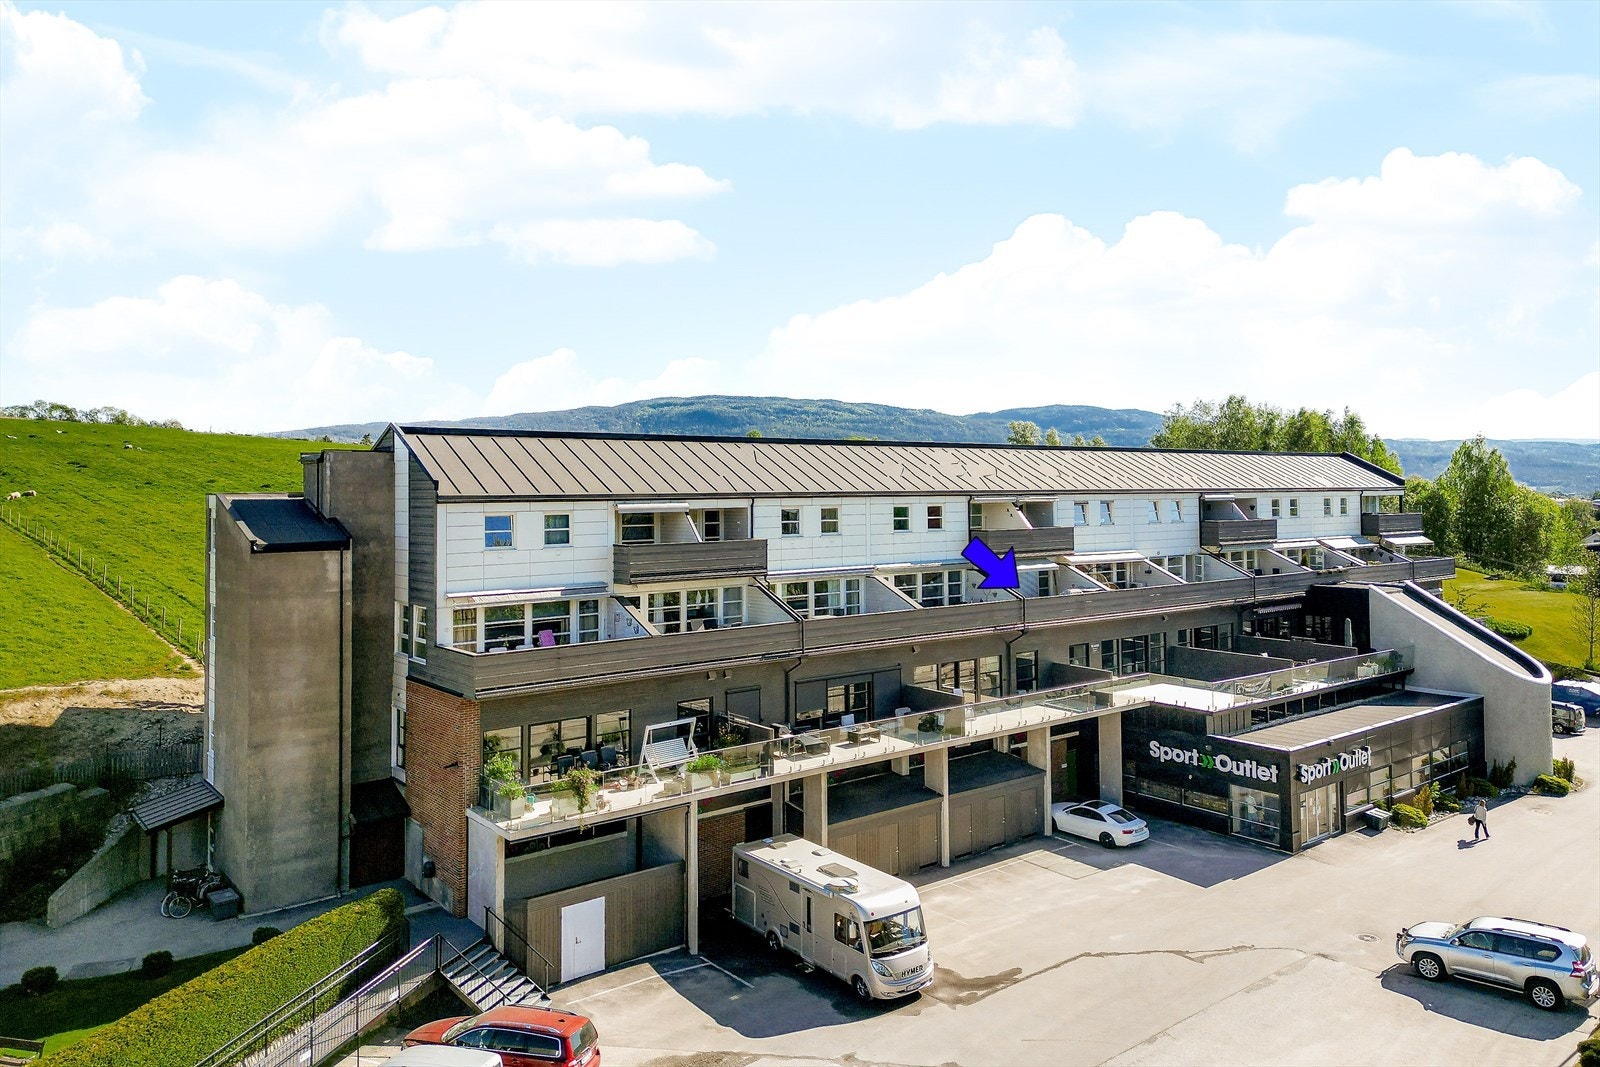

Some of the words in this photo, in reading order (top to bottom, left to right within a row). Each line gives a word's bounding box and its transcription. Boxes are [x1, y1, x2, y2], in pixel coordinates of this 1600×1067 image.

[1149, 740, 1199, 763] Sport
[1214, 754, 1279, 783] Outlet
[1300, 757, 1332, 785] Sport
[1340, 746, 1372, 772] Outlet
[901, 964, 924, 978] HYMER
